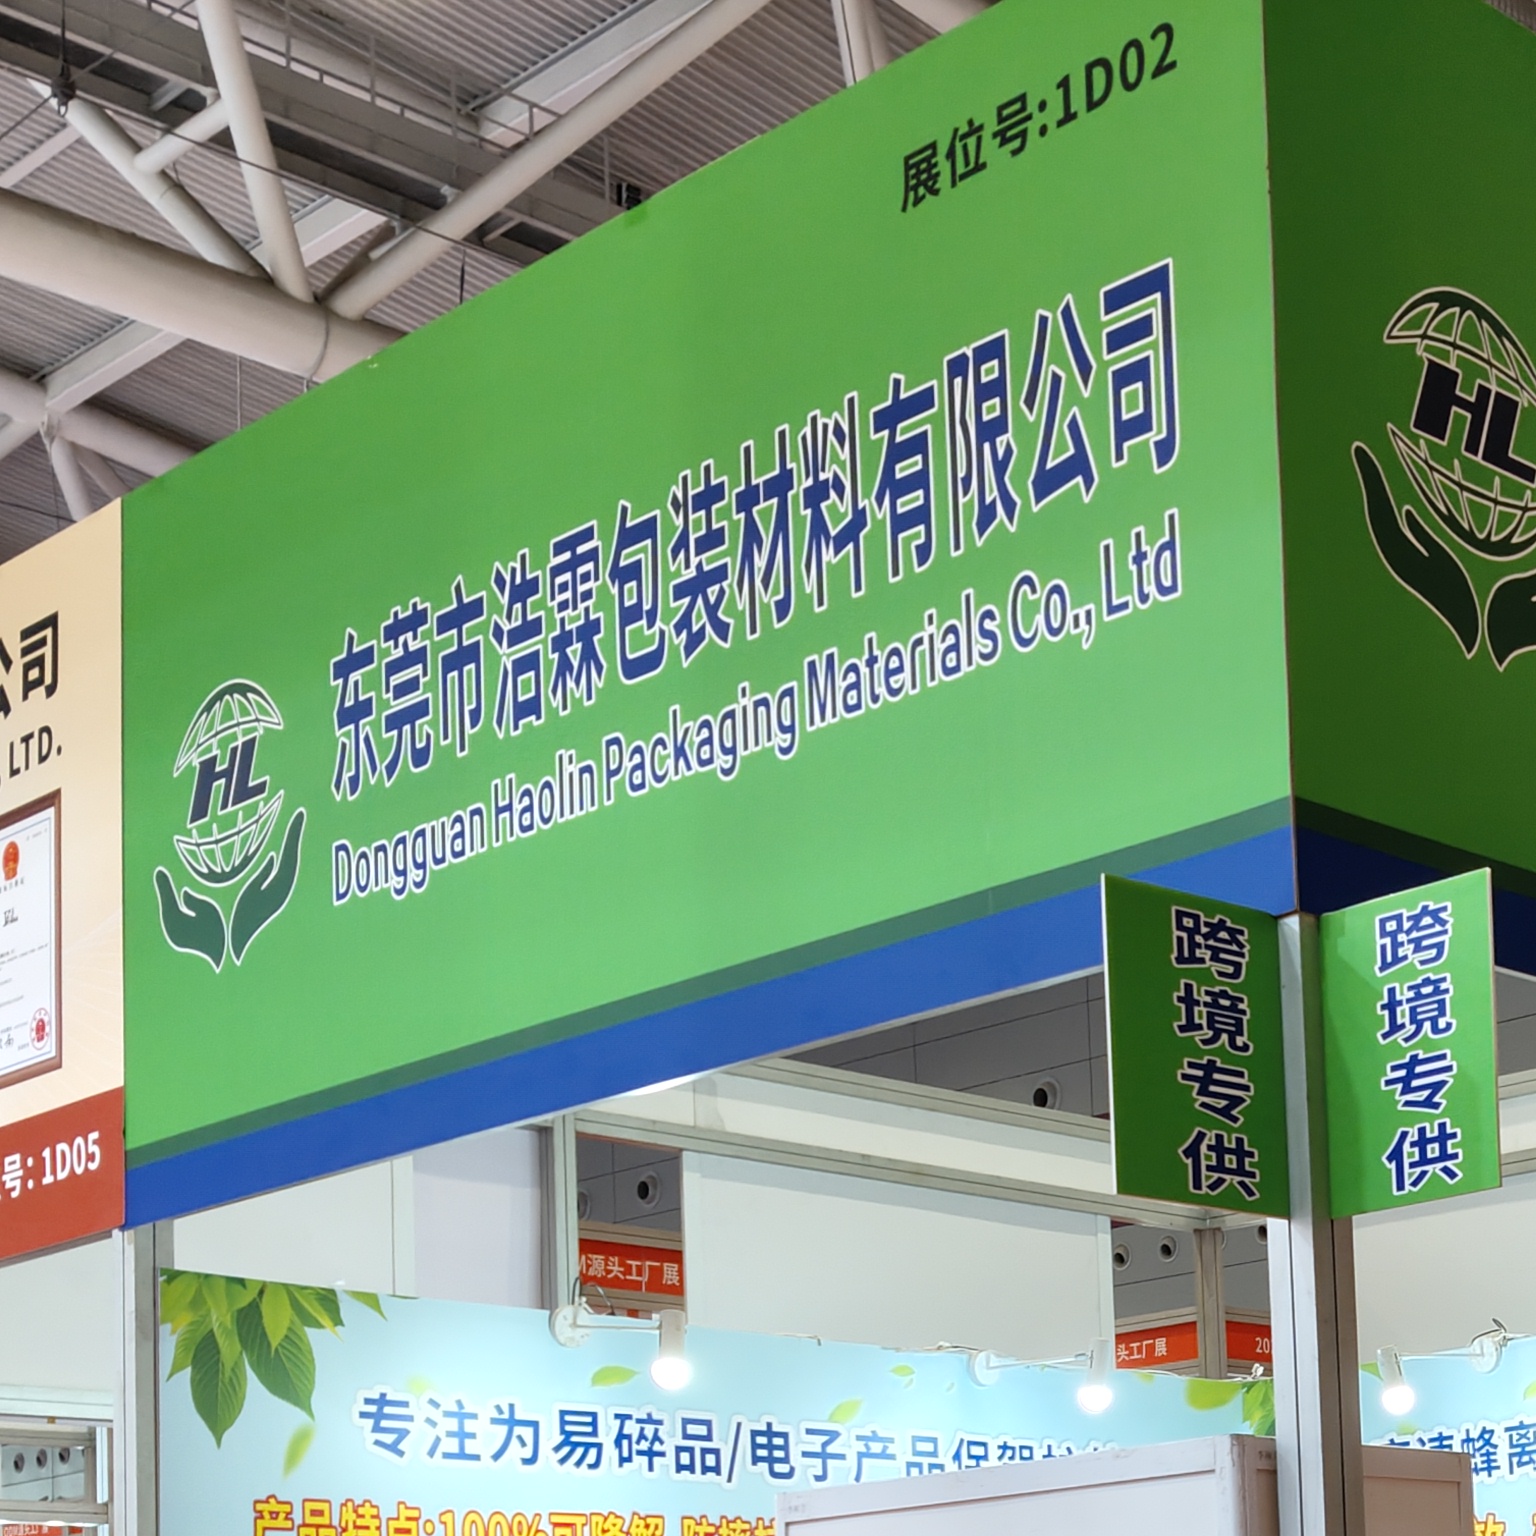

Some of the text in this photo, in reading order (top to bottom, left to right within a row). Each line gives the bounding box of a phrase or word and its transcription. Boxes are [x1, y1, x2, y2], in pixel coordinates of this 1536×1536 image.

[901, 22, 1178, 213] 展位号:1D02
[330, 257, 1180, 801] 东莞市浩霖包装材料有限公司
[7, 724, 64, 781] LTD.
[187, 734, 270, 828] HL
[332, 806, 486, 906] Dongguan
[492, 750, 596, 848] Haolin
[602, 680, 799, 804] Packaging
[804, 588, 1000, 732] Materials
[0, 1130, 101, 1201] 号：1D05
[1170, 905, 1260, 1201] 跨境专供
[1374, 901, 1463, 1197] 跨境专供
